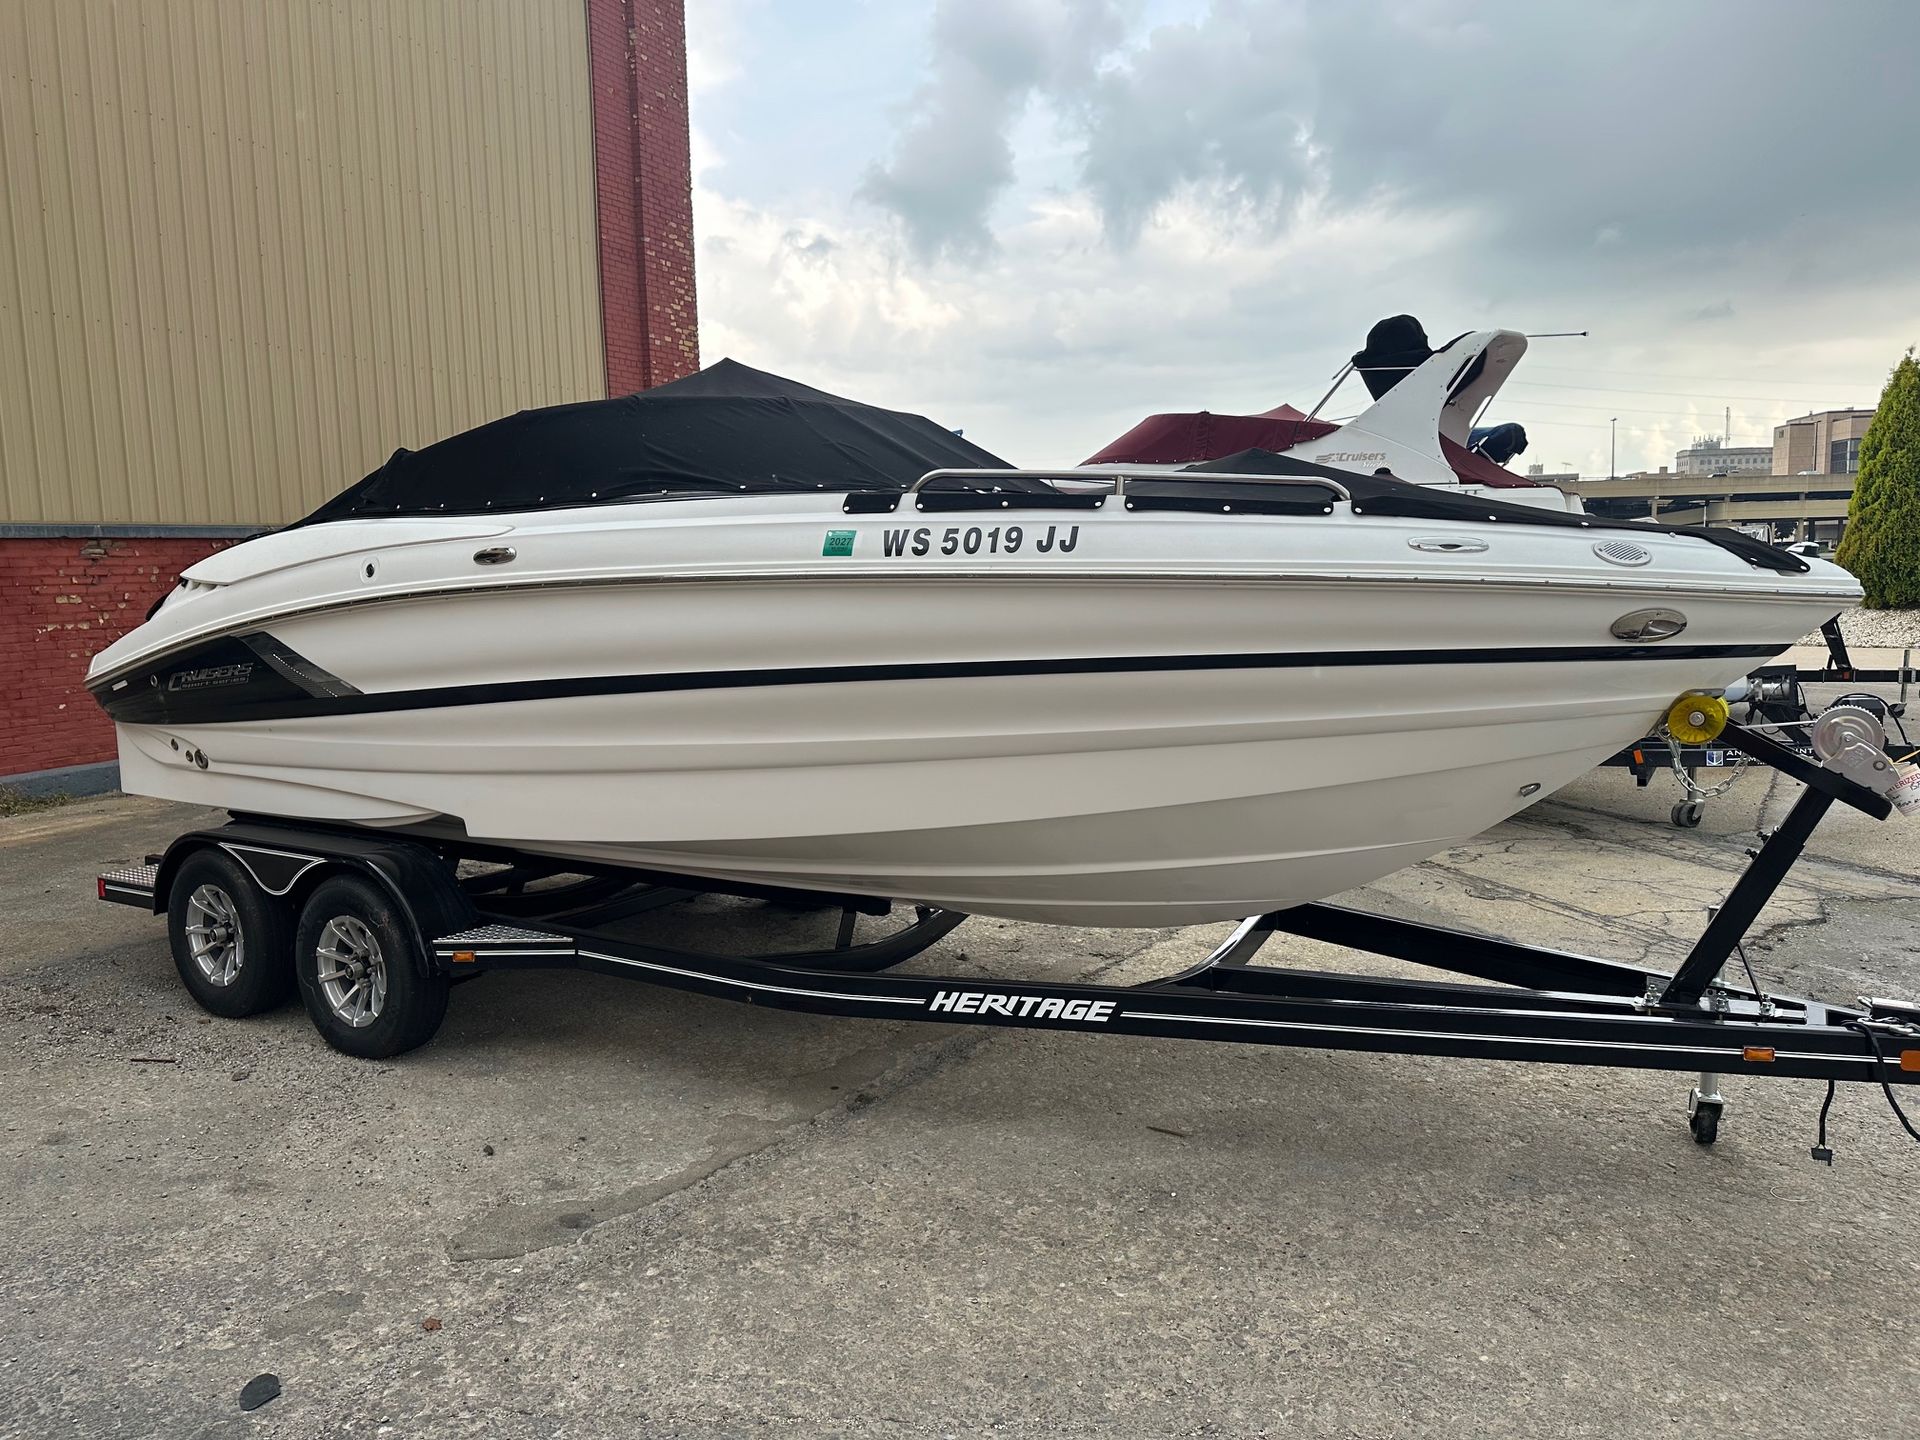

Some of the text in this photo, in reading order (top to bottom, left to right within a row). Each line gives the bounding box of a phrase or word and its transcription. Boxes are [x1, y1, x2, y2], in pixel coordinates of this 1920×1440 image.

[1338, 451, 1387, 462] Cruisers
[829, 537, 853, 546] 2027
[882, 525, 1080, 558] WS 5019 JJ
[168, 662, 254, 691] CRUISERS
[929, 990, 1117, 1022] HERITAGE
